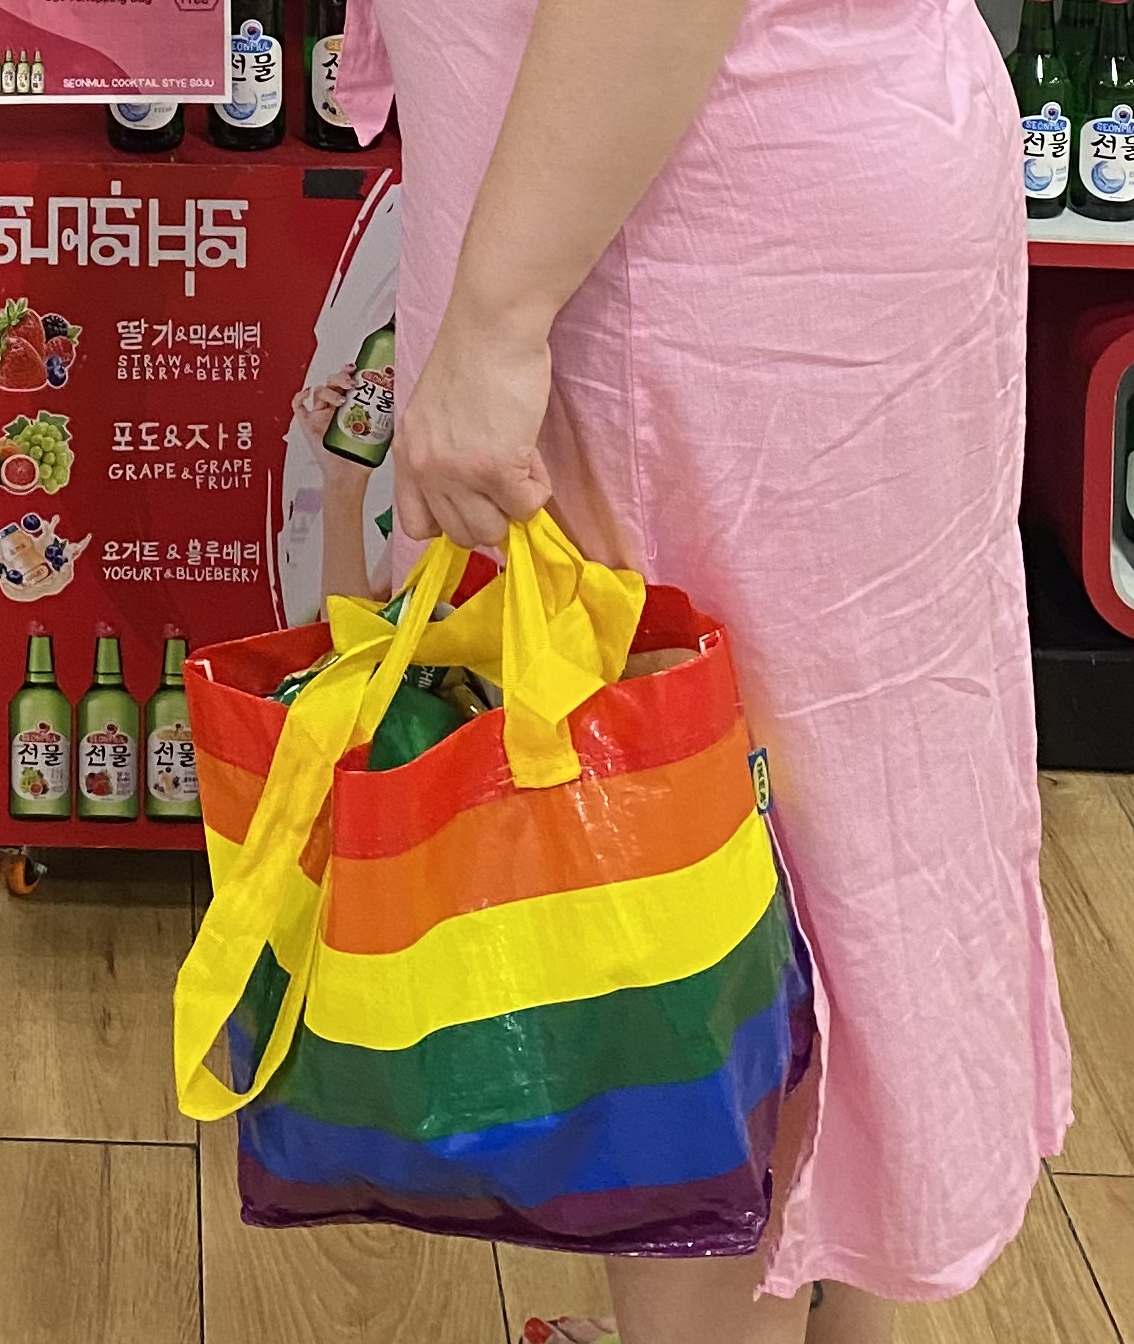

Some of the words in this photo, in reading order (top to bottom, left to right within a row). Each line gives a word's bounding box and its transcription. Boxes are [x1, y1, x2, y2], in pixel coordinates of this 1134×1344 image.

[63, 78, 109, 88] SEONMUL
[189, 78, 215, 88] SOJU
[117, 354, 182, 367] STRAW
[196, 354, 261, 368] MIXED
[117, 367, 181, 380] BERRY
[196, 368, 260, 381] BERRY
[108, 462, 177, 481] GRAPE
[195, 458, 253, 474] GRAPE
[195, 473, 253, 490] FRUIT
[101, 539, 160, 563] 요거트
